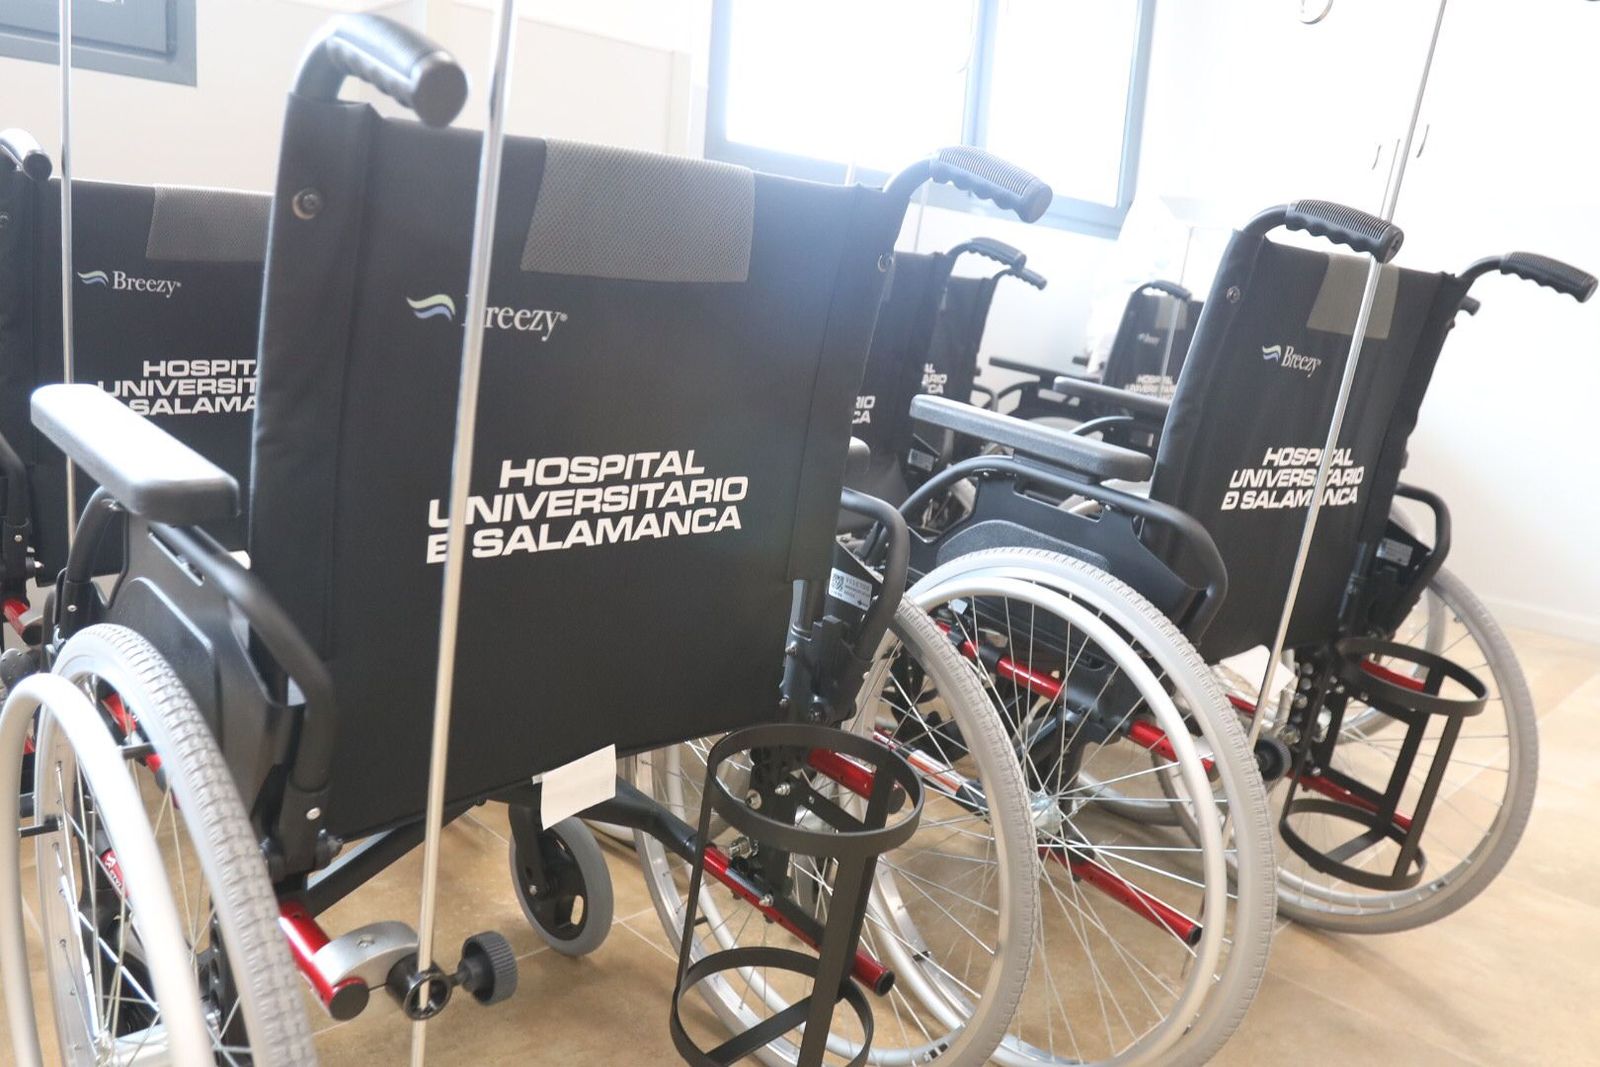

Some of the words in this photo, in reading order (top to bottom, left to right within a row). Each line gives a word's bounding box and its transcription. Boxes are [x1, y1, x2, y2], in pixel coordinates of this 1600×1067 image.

[112, 270, 177, 298] Breezy
[462, 294, 562, 342] reezy
[143, 359, 257, 377] HOSPIT
[98, 377, 258, 397] UNIVERSIT
[129, 396, 257, 416] SALAMA
[499, 449, 705, 488] HOSPITAL
[1229, 466, 1365, 489] UNIVERSARIO
[428, 476, 749, 528] UNIVERSITARIO
[1240, 486, 1359, 509] SALAMNCA
[472, 505, 742, 559] SALAMANCA
